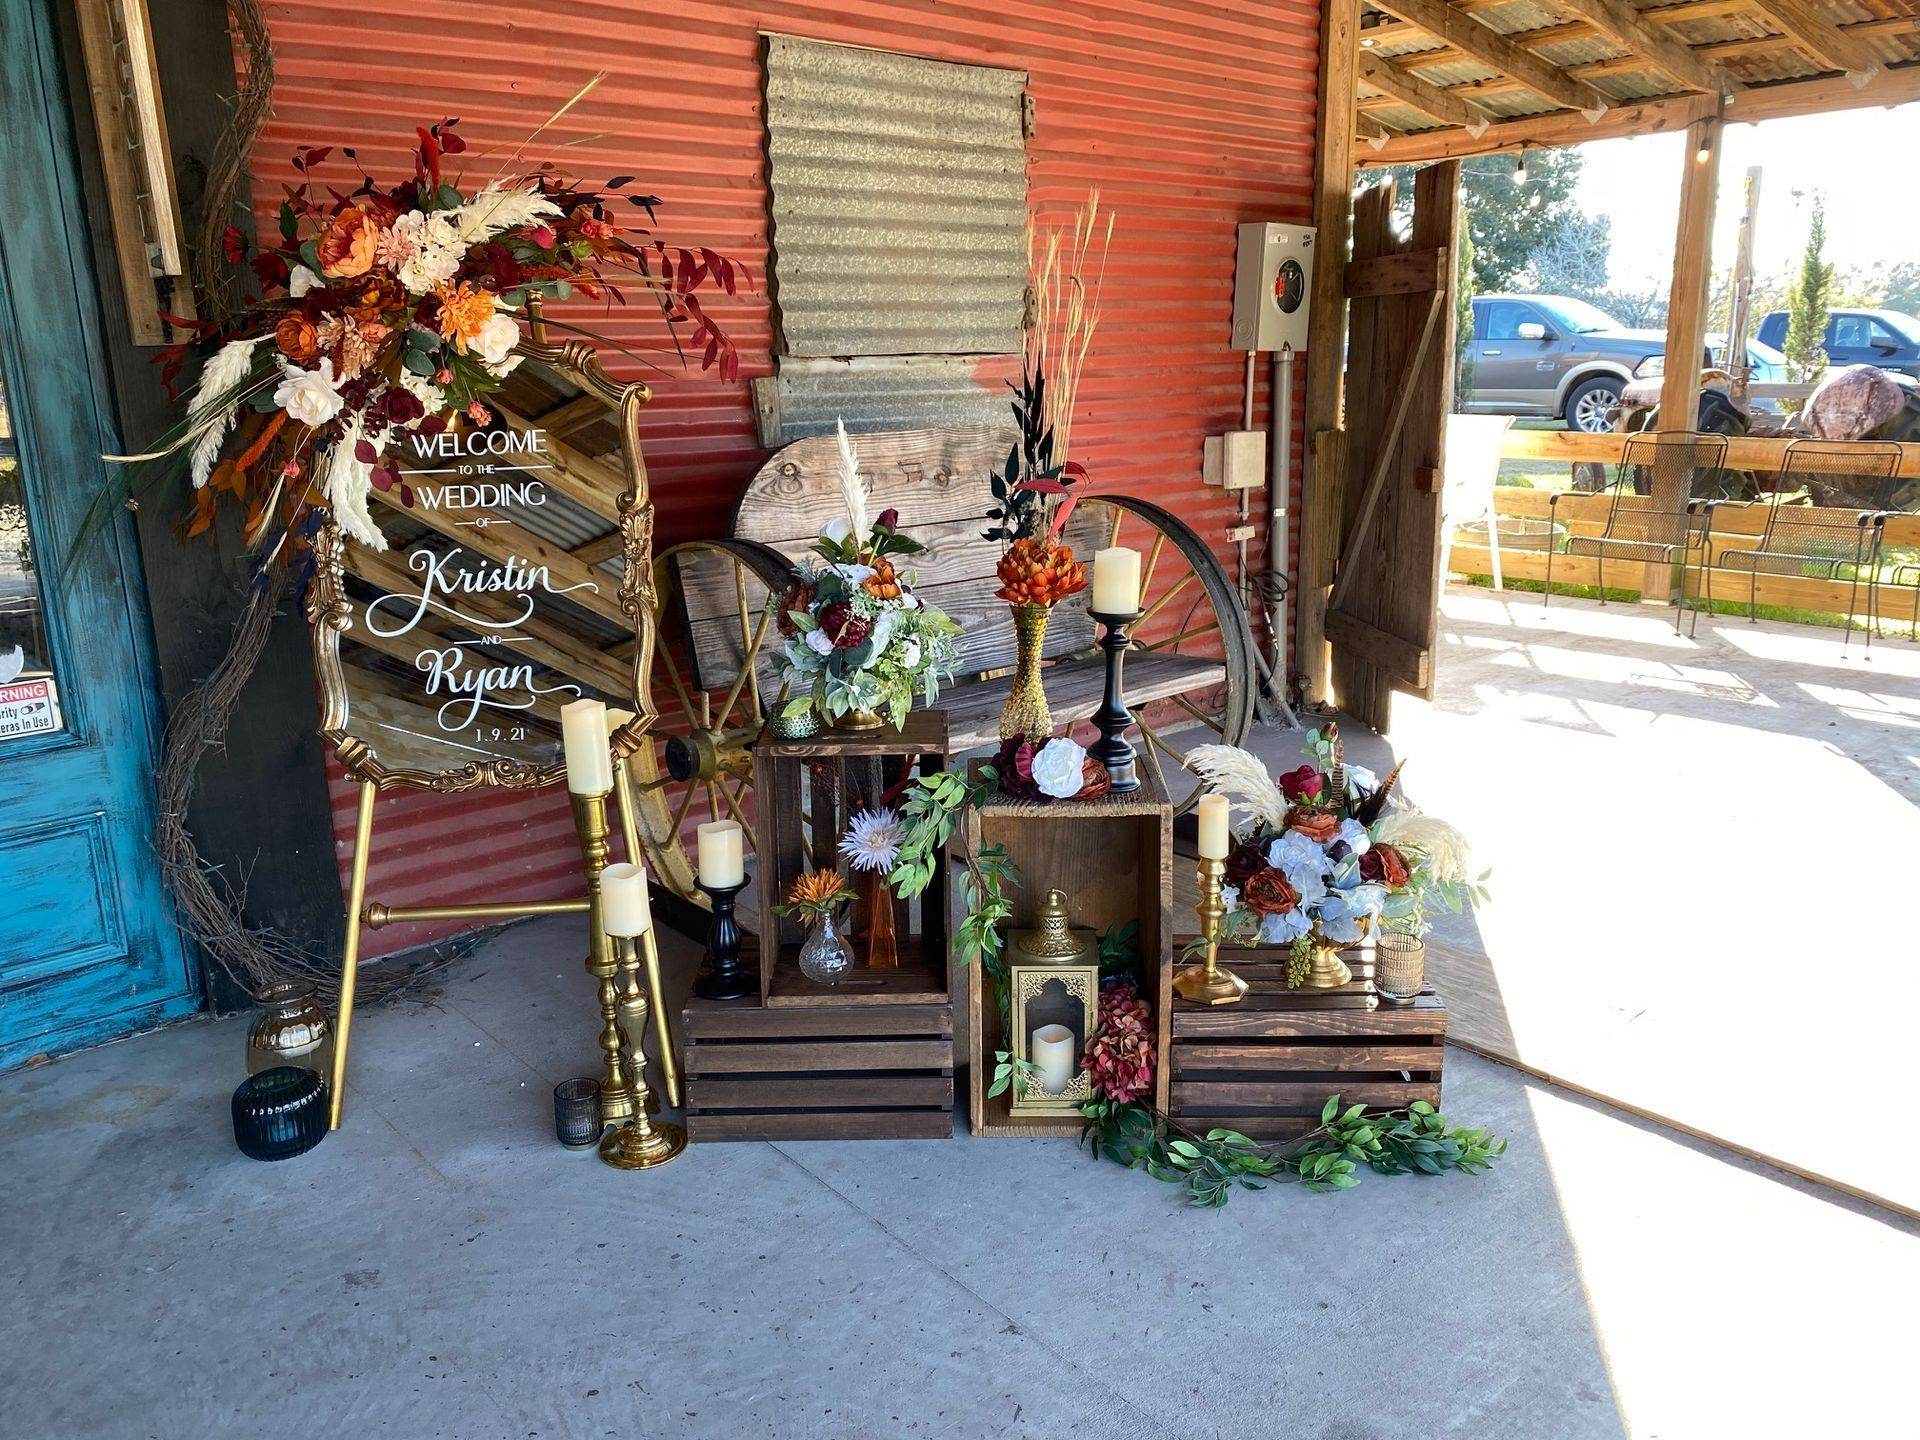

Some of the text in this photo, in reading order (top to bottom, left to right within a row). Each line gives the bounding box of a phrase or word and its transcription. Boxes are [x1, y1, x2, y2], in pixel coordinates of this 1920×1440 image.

[411, 429, 547, 459] WELCOME
[457, 464, 495, 475] TO THE
[417, 481, 546, 511] WEDDING
[475, 518, 490, 528] OF
[365, 548, 598, 637] Kristin
[480, 635, 502, 645] AND
[415, 648, 581, 731] Ryan
[0, 707, 17, 719] rity
[0, 717, 49, 734] eras In Use
